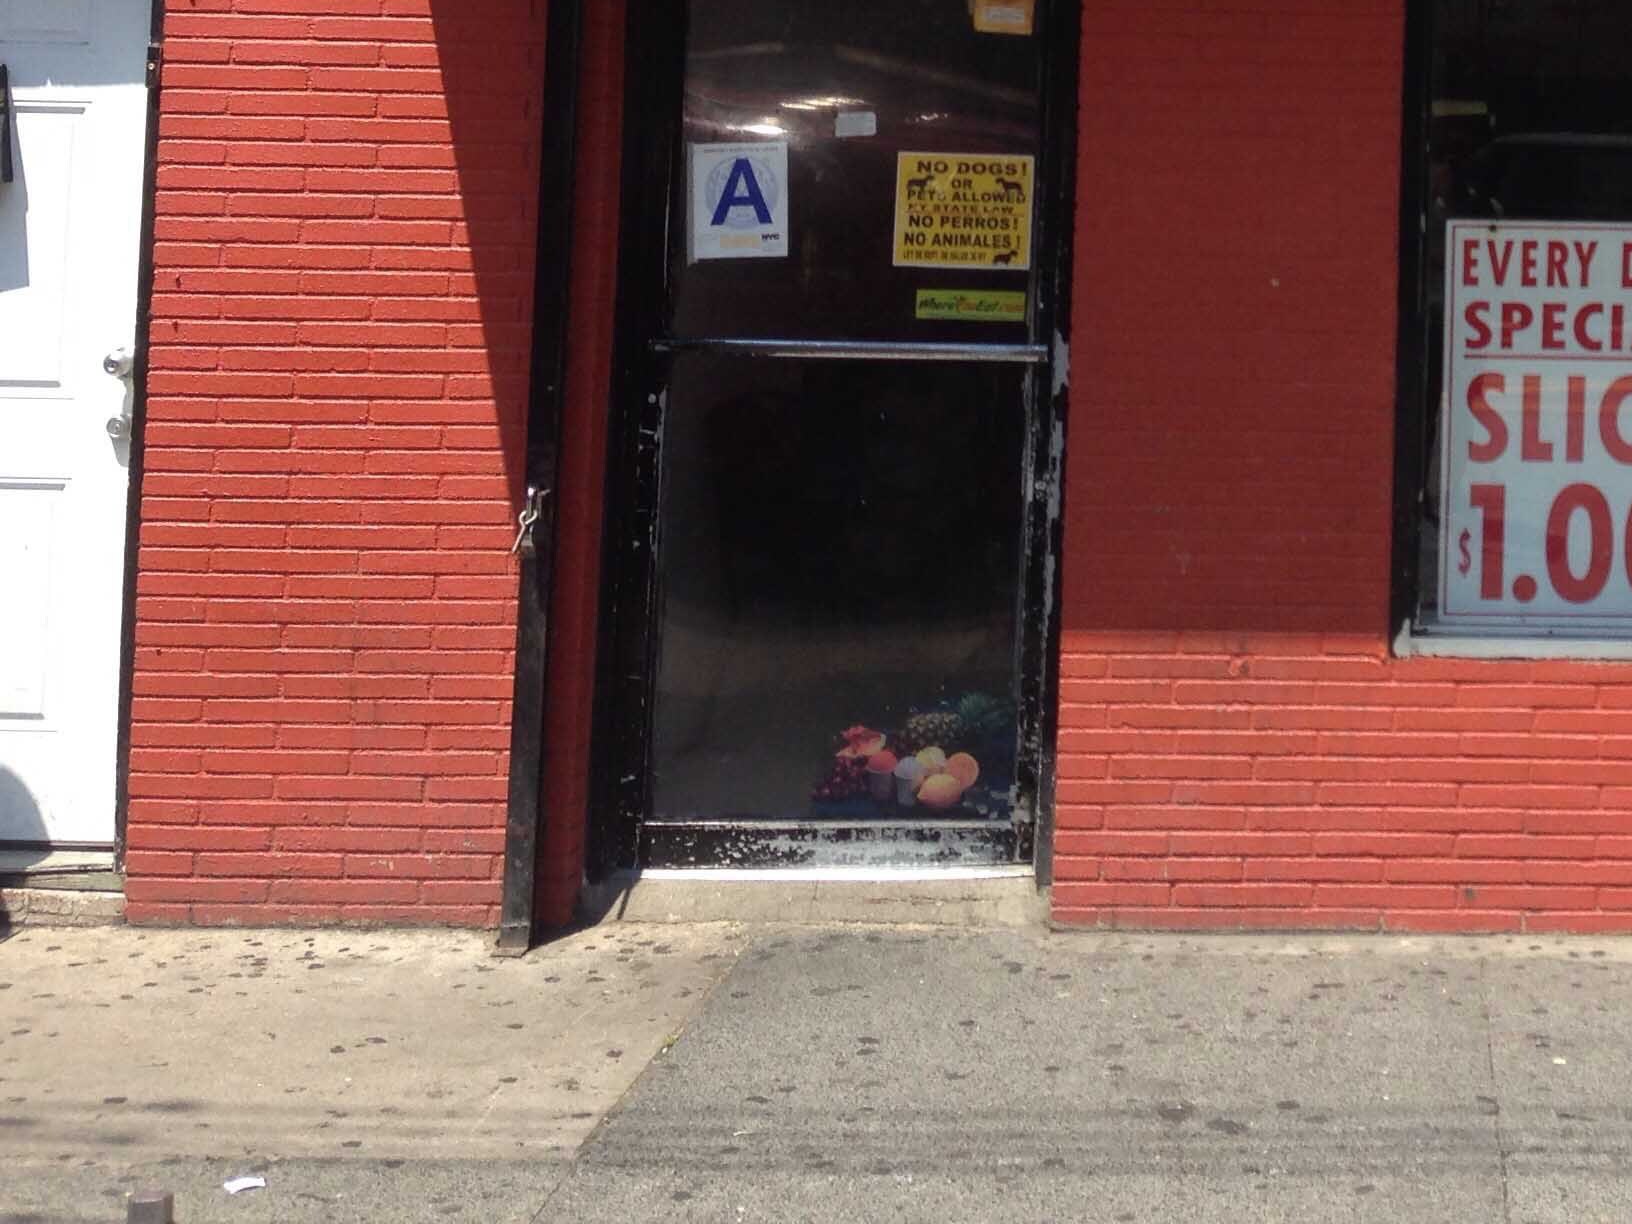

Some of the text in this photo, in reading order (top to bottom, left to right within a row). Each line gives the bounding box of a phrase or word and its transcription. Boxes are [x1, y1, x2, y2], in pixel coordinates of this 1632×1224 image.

[917, 160, 949, 174] NO
[951, 177, 973, 190] OR
[711, 157, 773, 226] A
[908, 215, 934, 228] NO
[904, 232, 926, 246] NO
[1462, 239, 1599, 289] EVERY
